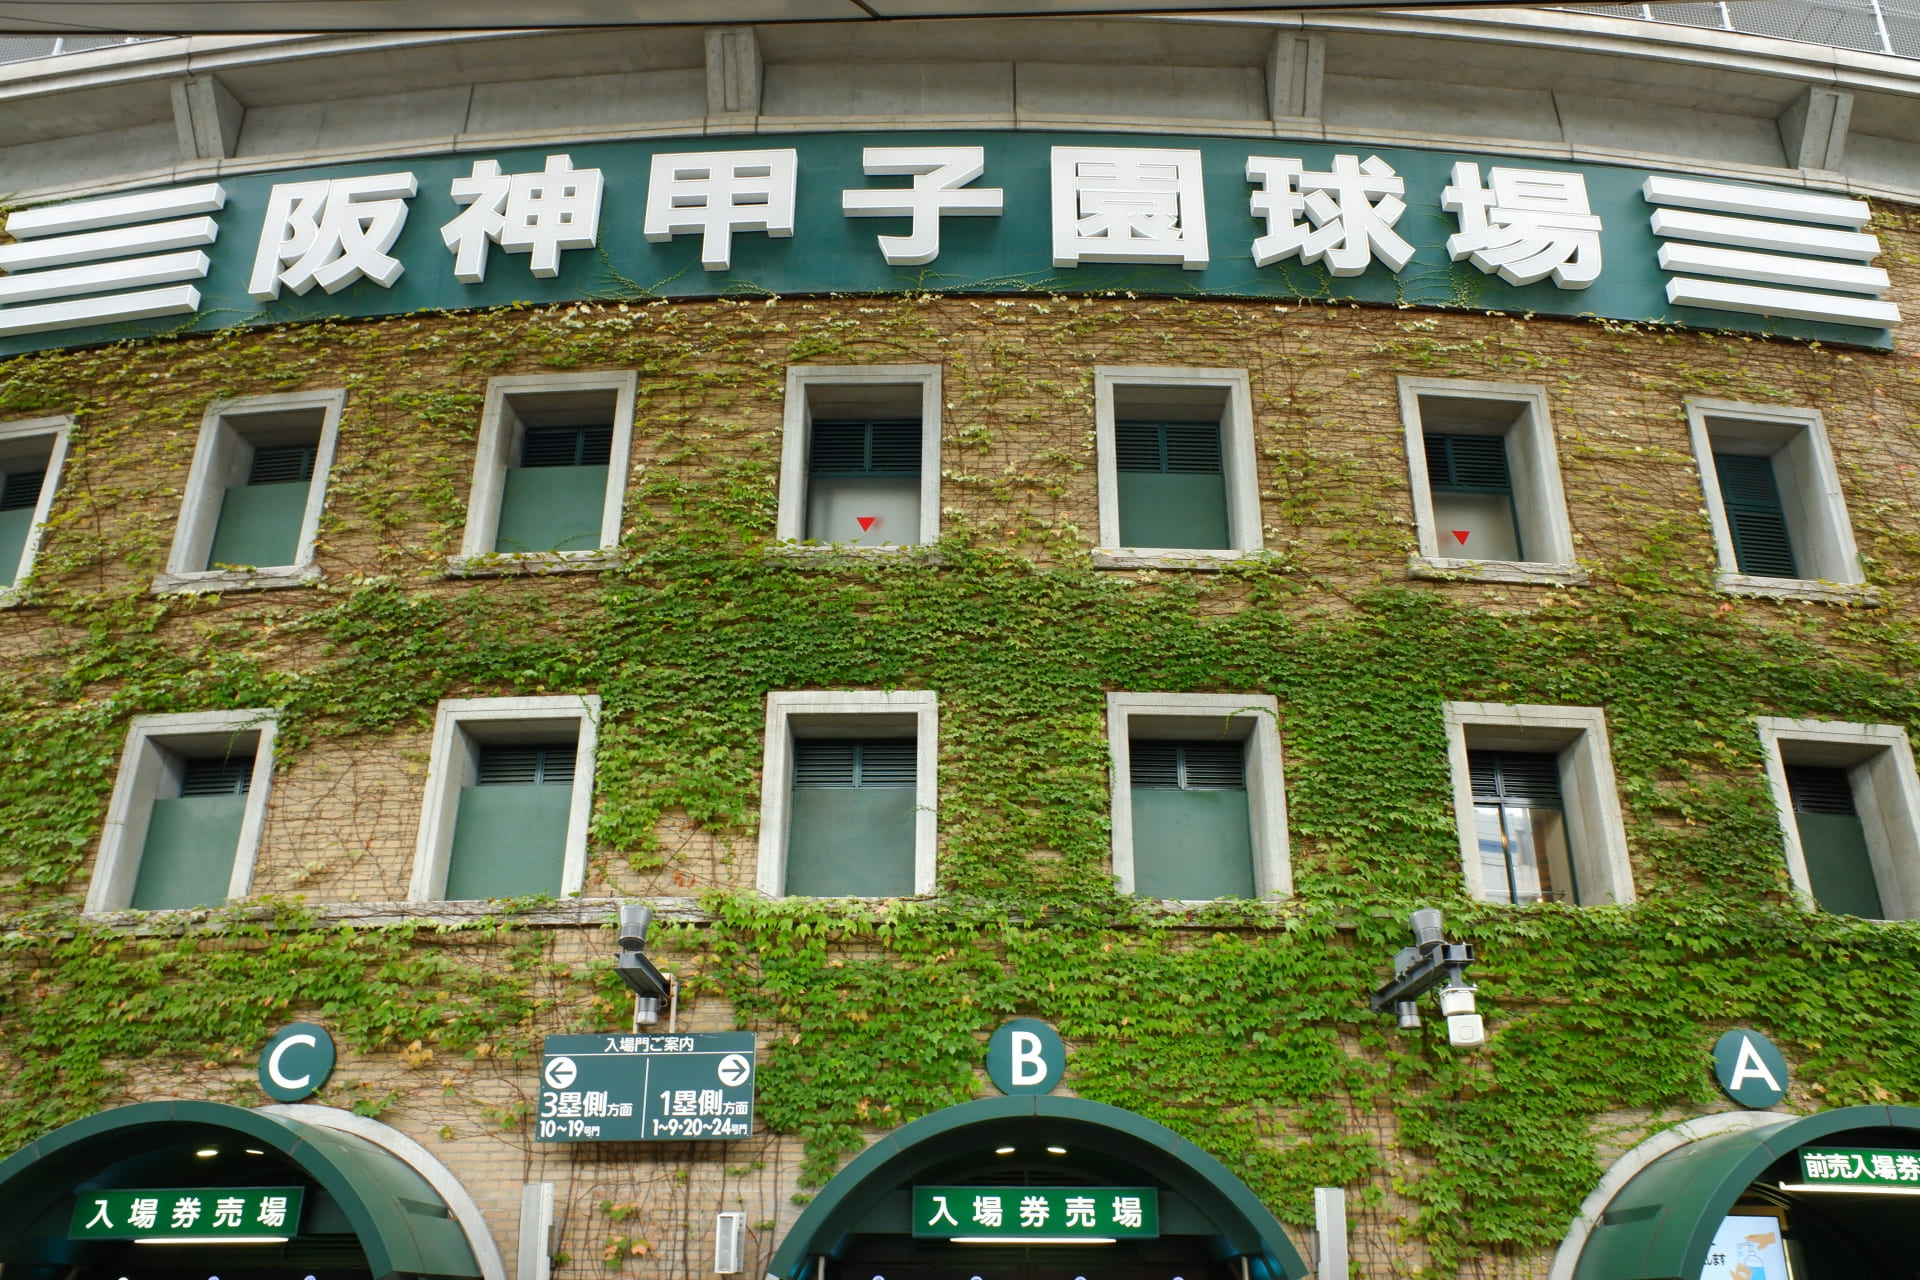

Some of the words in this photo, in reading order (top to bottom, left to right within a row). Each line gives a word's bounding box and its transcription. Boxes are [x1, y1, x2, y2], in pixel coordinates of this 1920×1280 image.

[247, 145, 1602, 302] 阪神甲子園球場
[268, 1033, 316, 1089] C
[604, 1036, 695, 1053] 入場門ご案内
[1011, 1031, 1048, 1086] B
[1729, 1035, 1782, 1092] A
[540, 1090, 633, 1118] 3塁側方面
[660, 1088, 749, 1116] 1塁側方面
[1803, 1152, 1920, 1181] 前売入場券
[85, 1195, 288, 1230] 入場券売場
[928, 1195, 1143, 1228] 入場券売場
